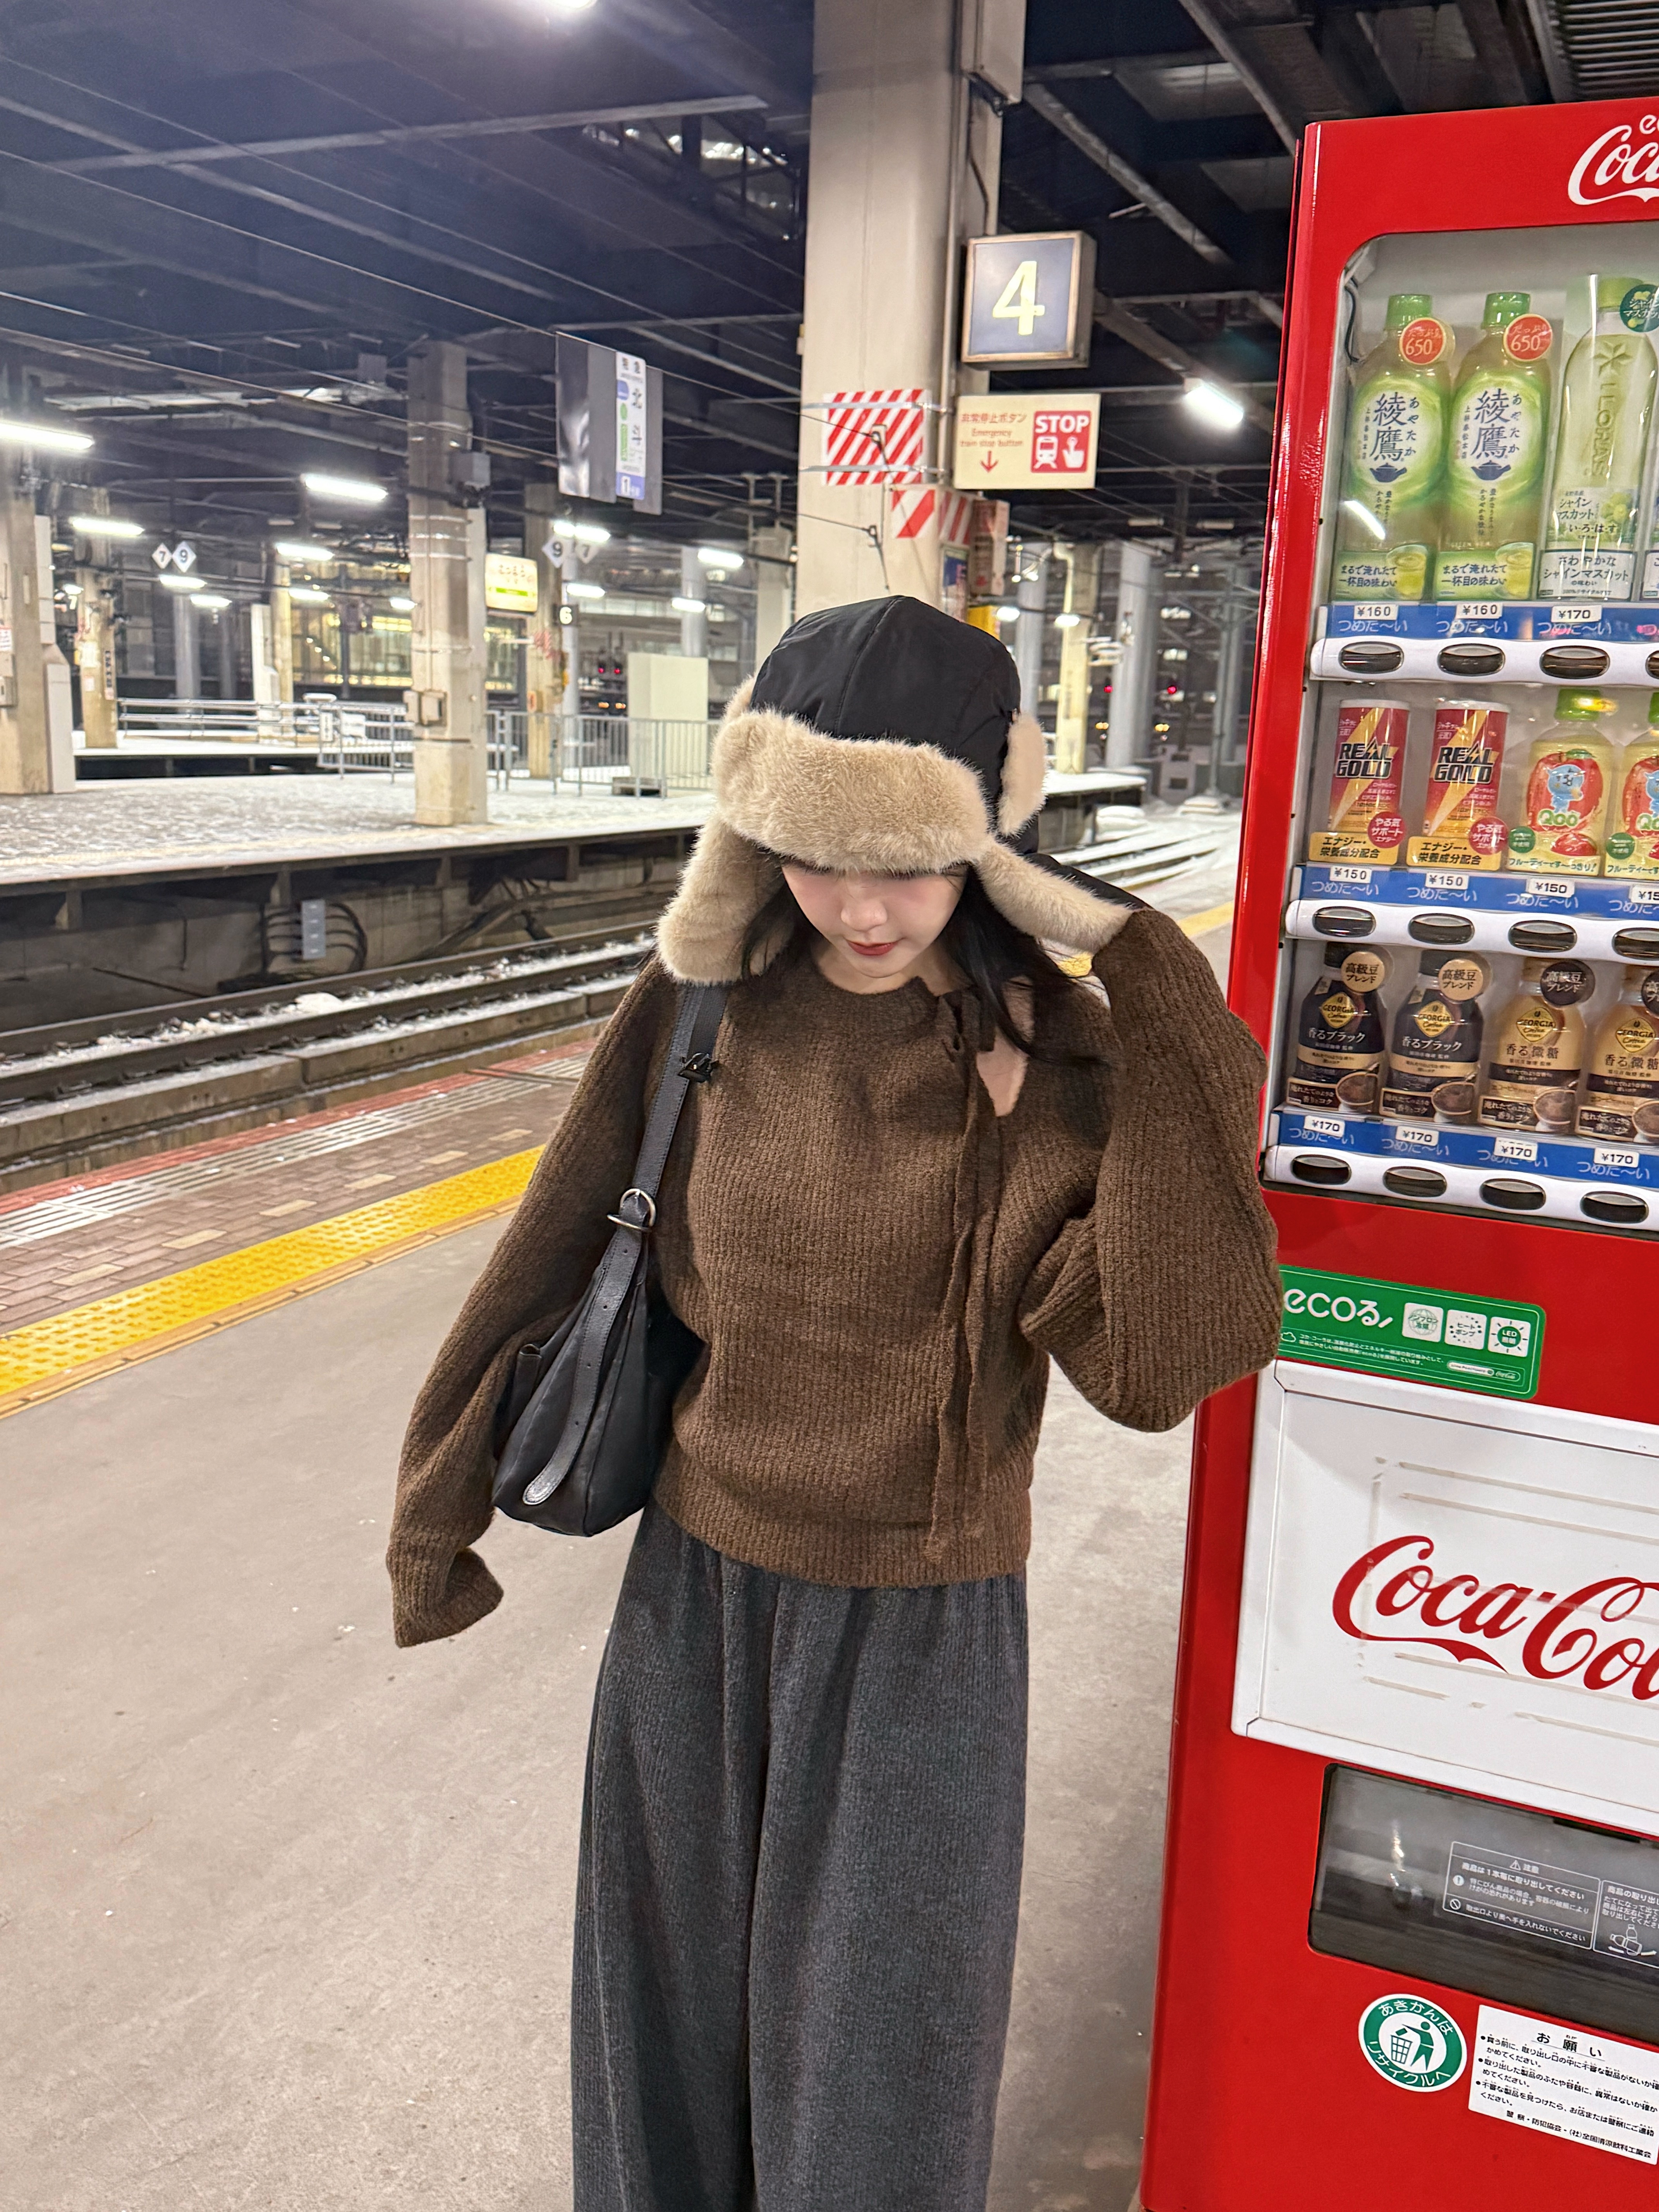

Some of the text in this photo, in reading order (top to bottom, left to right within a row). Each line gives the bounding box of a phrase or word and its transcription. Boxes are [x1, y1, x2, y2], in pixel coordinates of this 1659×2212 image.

[1639, 115, 1659, 134] e
[993, 261, 1045, 335] 4
[1405, 338, 1432, 356] 650
[1511, 334, 1540, 352] 650
[1035, 415, 1089, 433] STOP
[1369, 392, 1407, 461] 綾鷹
[1404, 397, 1419, 456] あやたか
[1470, 388, 1511, 459] 綾鷹
[1508, 394, 1522, 453] あやたか
[180, 549, 189, 563] 9
[1443, 564, 1507, 575] まるで淹れたて
[1441, 576, 1507, 586] 一杯目の味わい
[560, 606, 572, 624] 6
[1357, 607, 1391, 616] ¥160
[1462, 605, 1498, 615] ¥160
[1559, 610, 1591, 619] ¥170
[1339, 737, 1393, 760] REAL
[1437, 741, 1494, 766] REAL
[1336, 760, 1392, 779] GOLD
[1434, 764, 1493, 784] GOLD
[1376, 818, 1401, 827] やる気
[1538, 809, 1580, 830] Qoo
[1372, 827, 1403, 836] サポート
[1477, 824, 1504, 833] やる気
[1320, 847, 1380, 859] 栄養成分配合
[1418, 853, 1482, 865] 栄養成分配合
[1334, 868, 1367, 879] ¥150
[1429, 875, 1463, 886] ¥150
[1535, 883, 1567, 893] ¥150
[1346, 963, 1379, 975] 高級豆
[1442, 969, 1477, 981] 高級豆
[1346, 974, 1376, 983] ブレンド
[1443, 981, 1473, 990] ブレンド
[1309, 1027, 1366, 1043] 香るブラック
[1402, 1036, 1462, 1052] 香るブラック
[1507, 1044, 1559, 1059] 香る微糖
[1606, 1054, 1659, 1070] 香る微糖
[1312, 1120, 1340, 1132] ¥170
[1403, 1130, 1432, 1142] ¥170
[1502, 1145, 1532, 1158] ¥170
[1601, 1153, 1633, 1164] ¥170
[1602, 1908, 1659, 1929] 取り出してくださ
[1378, 2000, 1453, 2035] あきかんは
[1367, 2041, 1451, 2086] リサイクルへ
[1486, 2047, 1542, 2068] かめてください。
[1482, 2069, 1530, 2088] めてください。
[1480, 2092, 1513, 2106] ください。
